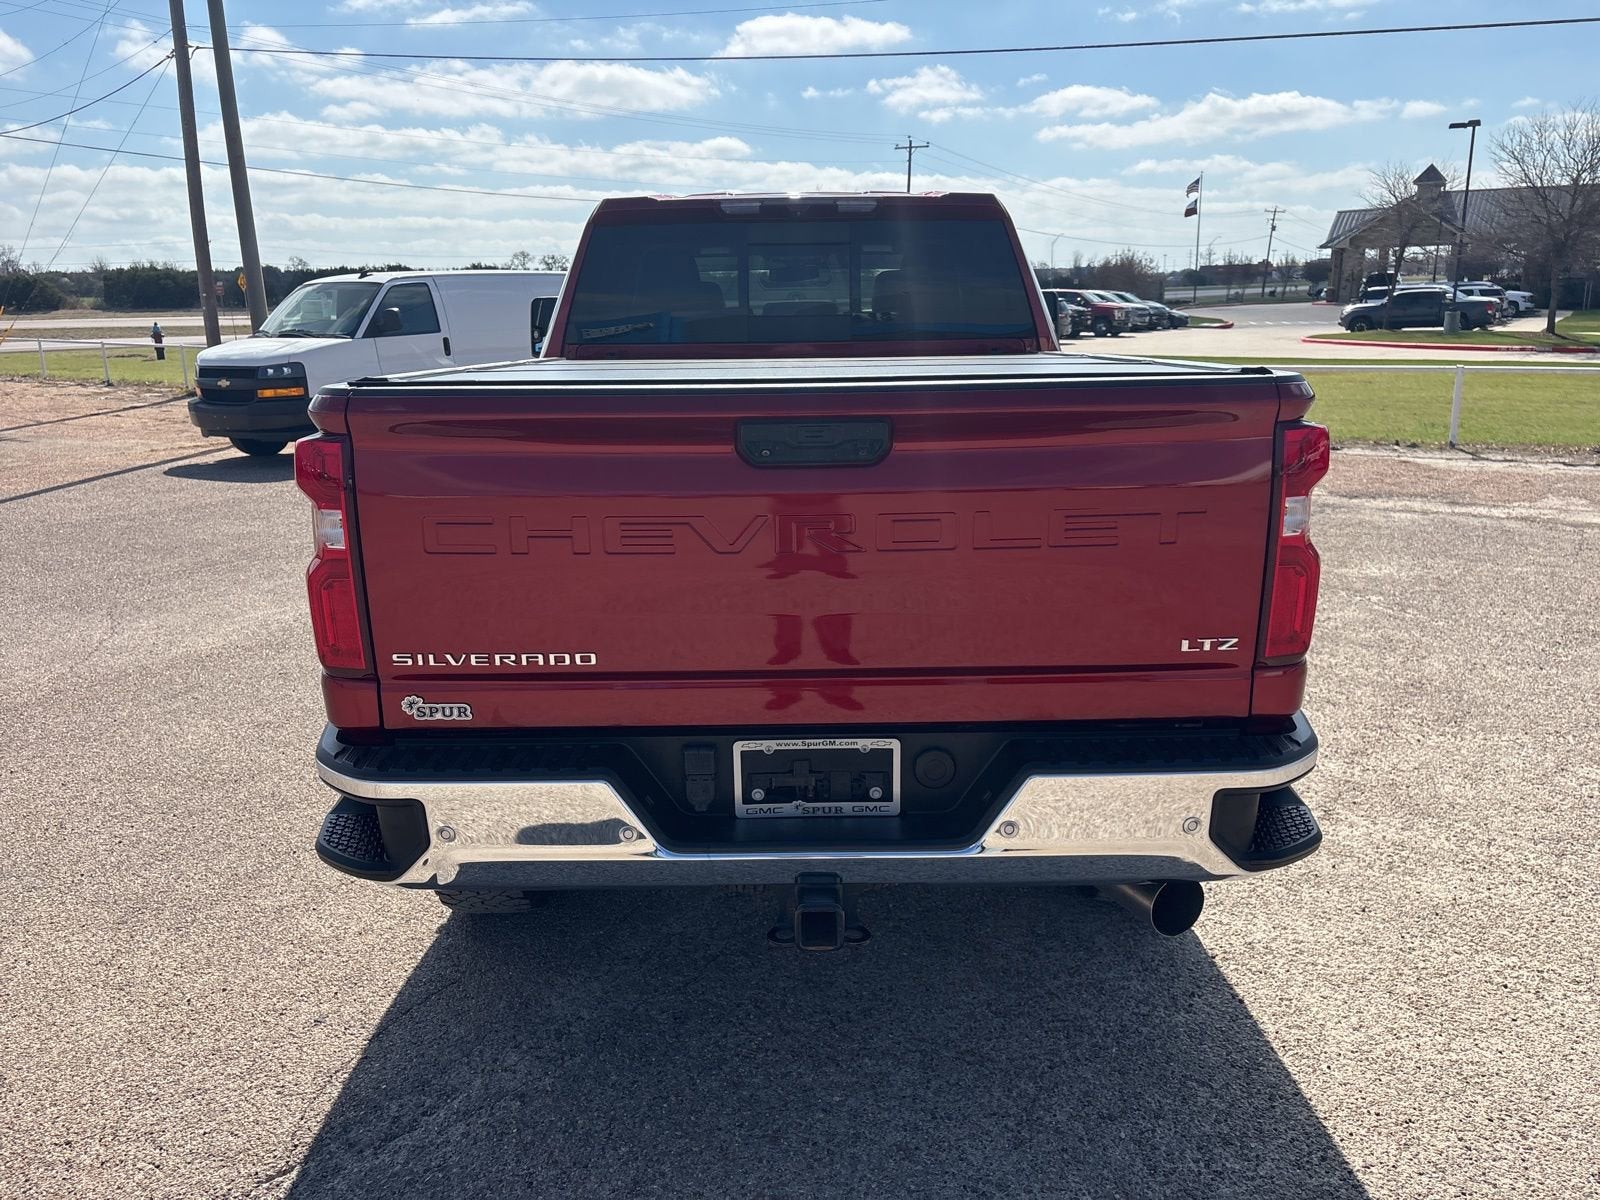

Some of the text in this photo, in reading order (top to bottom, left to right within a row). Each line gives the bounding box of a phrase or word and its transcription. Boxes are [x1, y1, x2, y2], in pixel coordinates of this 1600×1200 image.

[422, 507, 1208, 555] CHEVROLET
[1181, 638, 1239, 652] LTZ
[391, 653, 598, 666] SILVERADO
[416, 706, 471, 719] SPUR
[775, 740, 859, 749] www.SpurGM.com
[745, 805, 891, 815] GMC SPUR GMC
